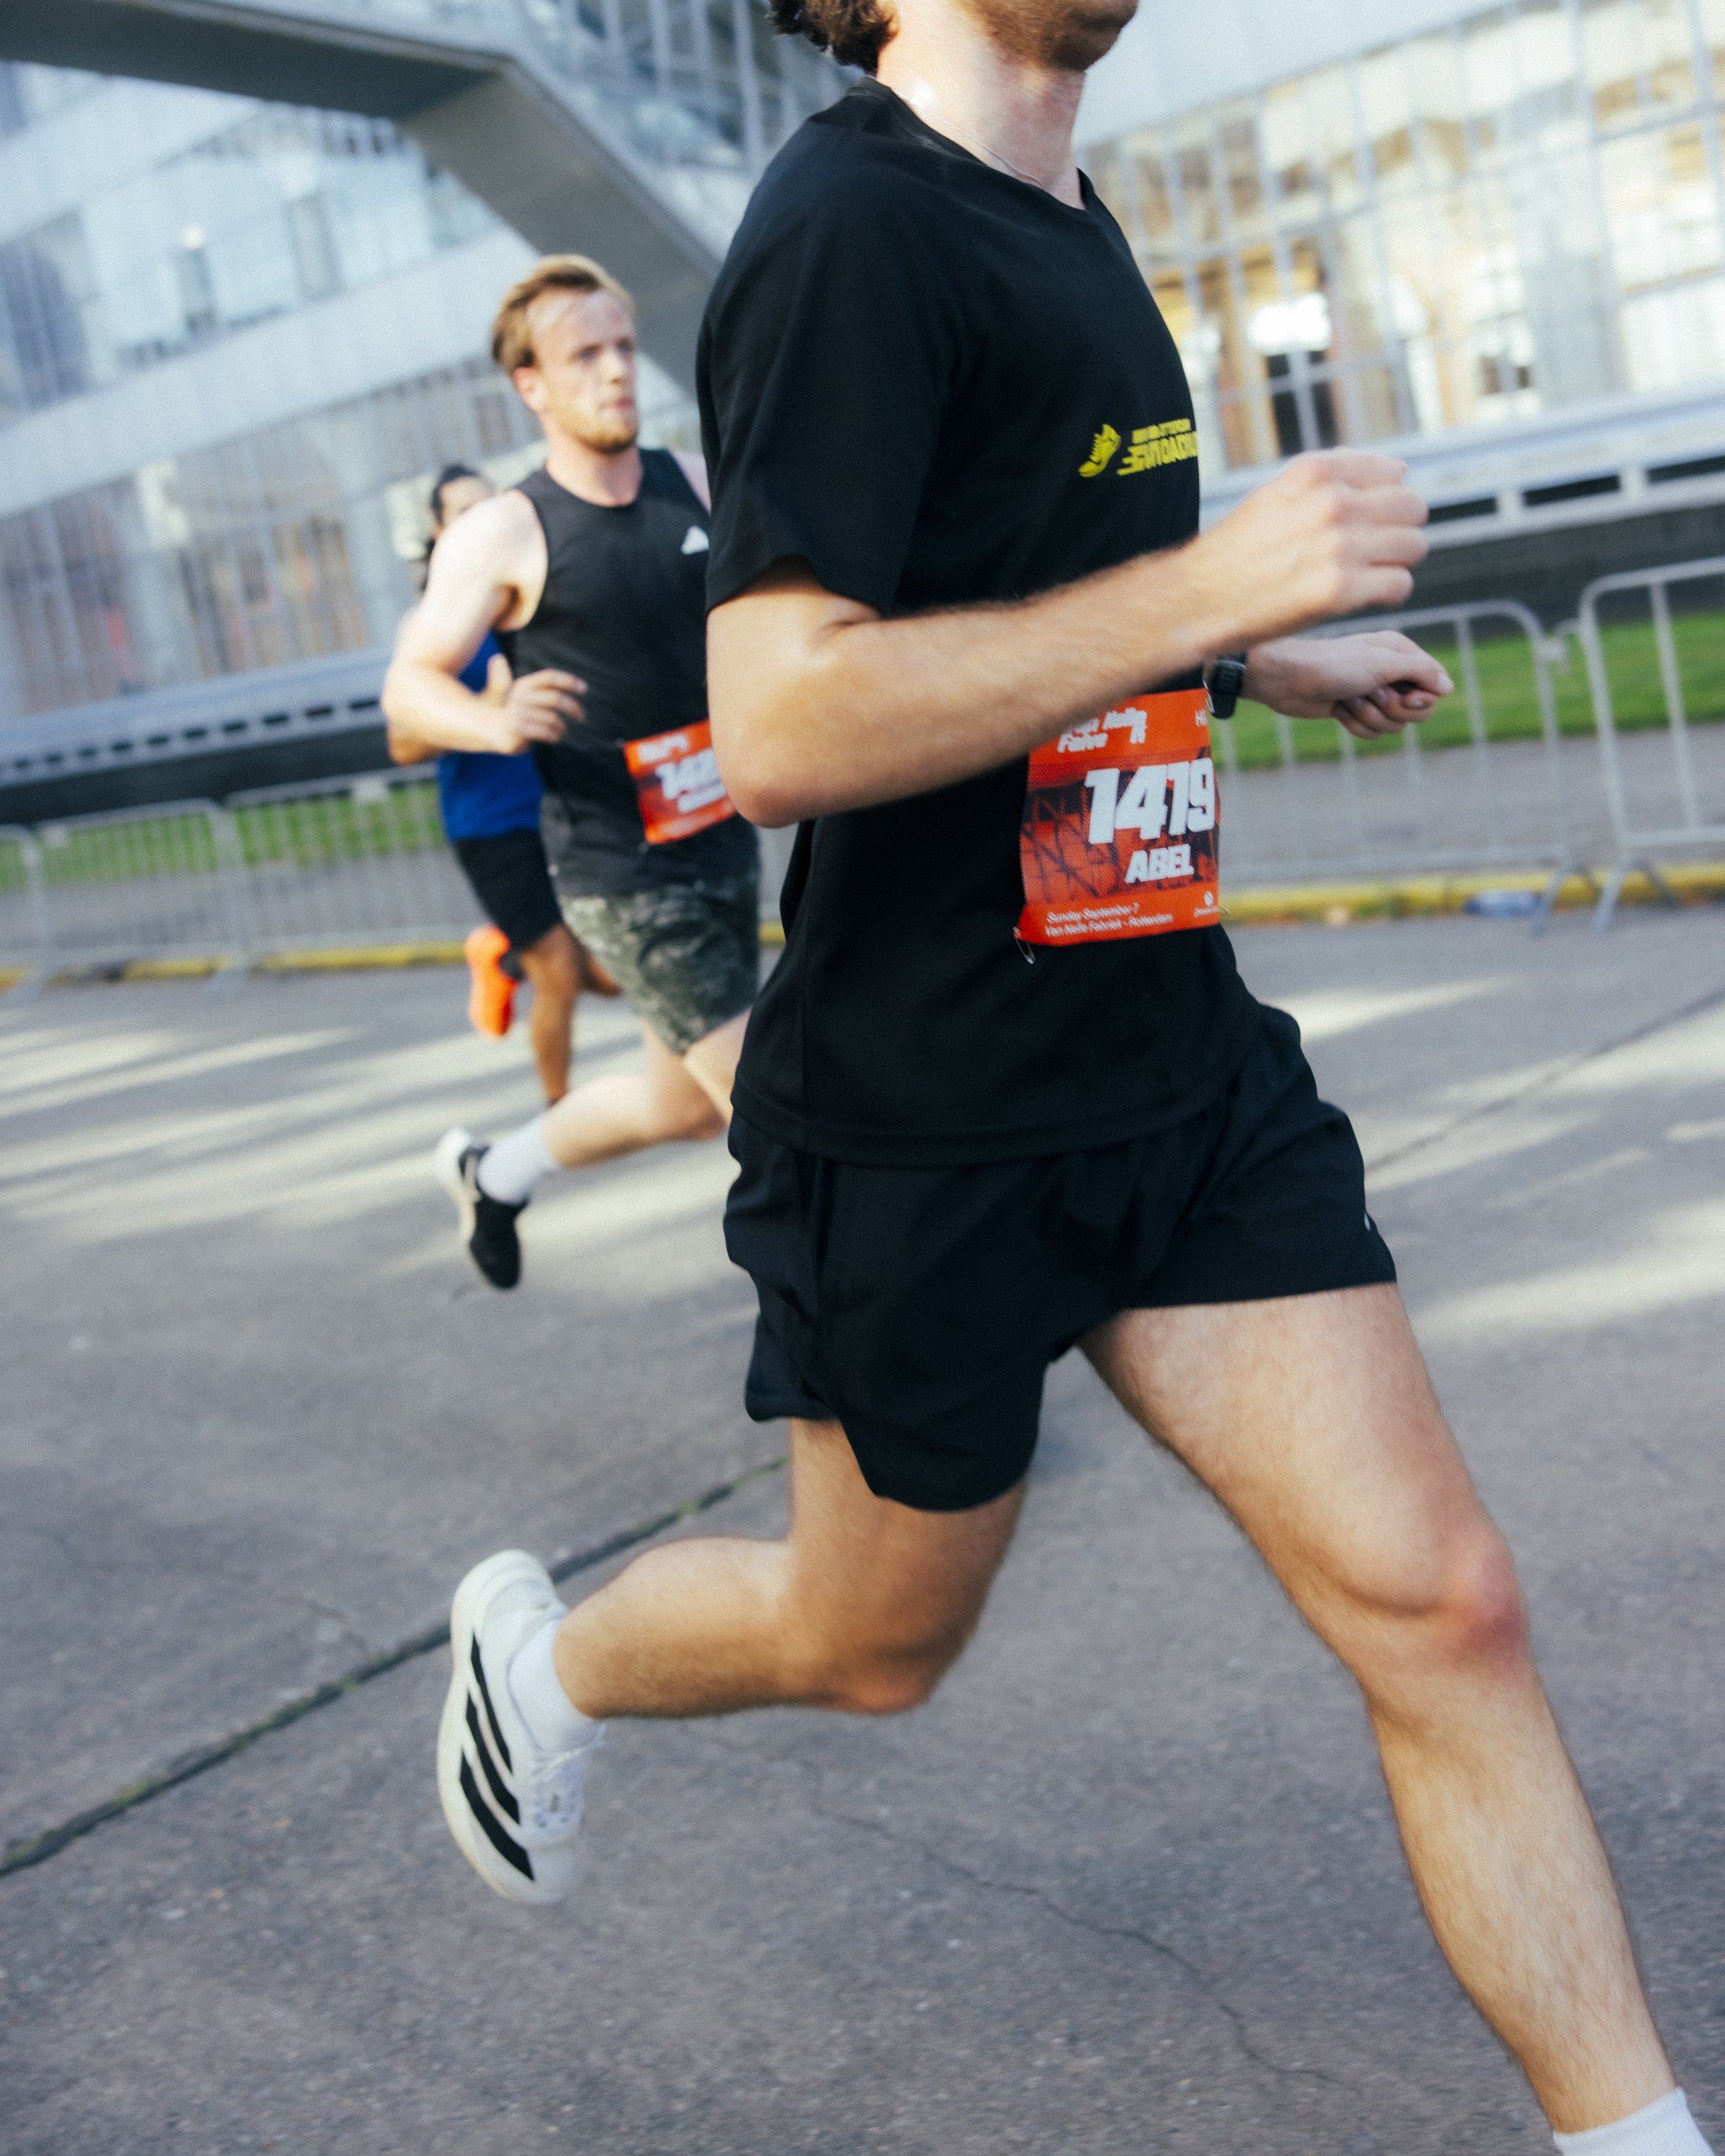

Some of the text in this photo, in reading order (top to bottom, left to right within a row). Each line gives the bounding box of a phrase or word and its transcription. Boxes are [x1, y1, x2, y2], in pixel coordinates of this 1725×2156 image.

[1084, 757, 1215, 844] 1419
[1125, 844, 1194, 883] ABEL
[1045, 926, 1063, 936] Van
[1128, 913, 1173, 927] Rotterdam
[1046, 911, 1082, 924] Sunday
[1082, 906, 1131, 918] September
